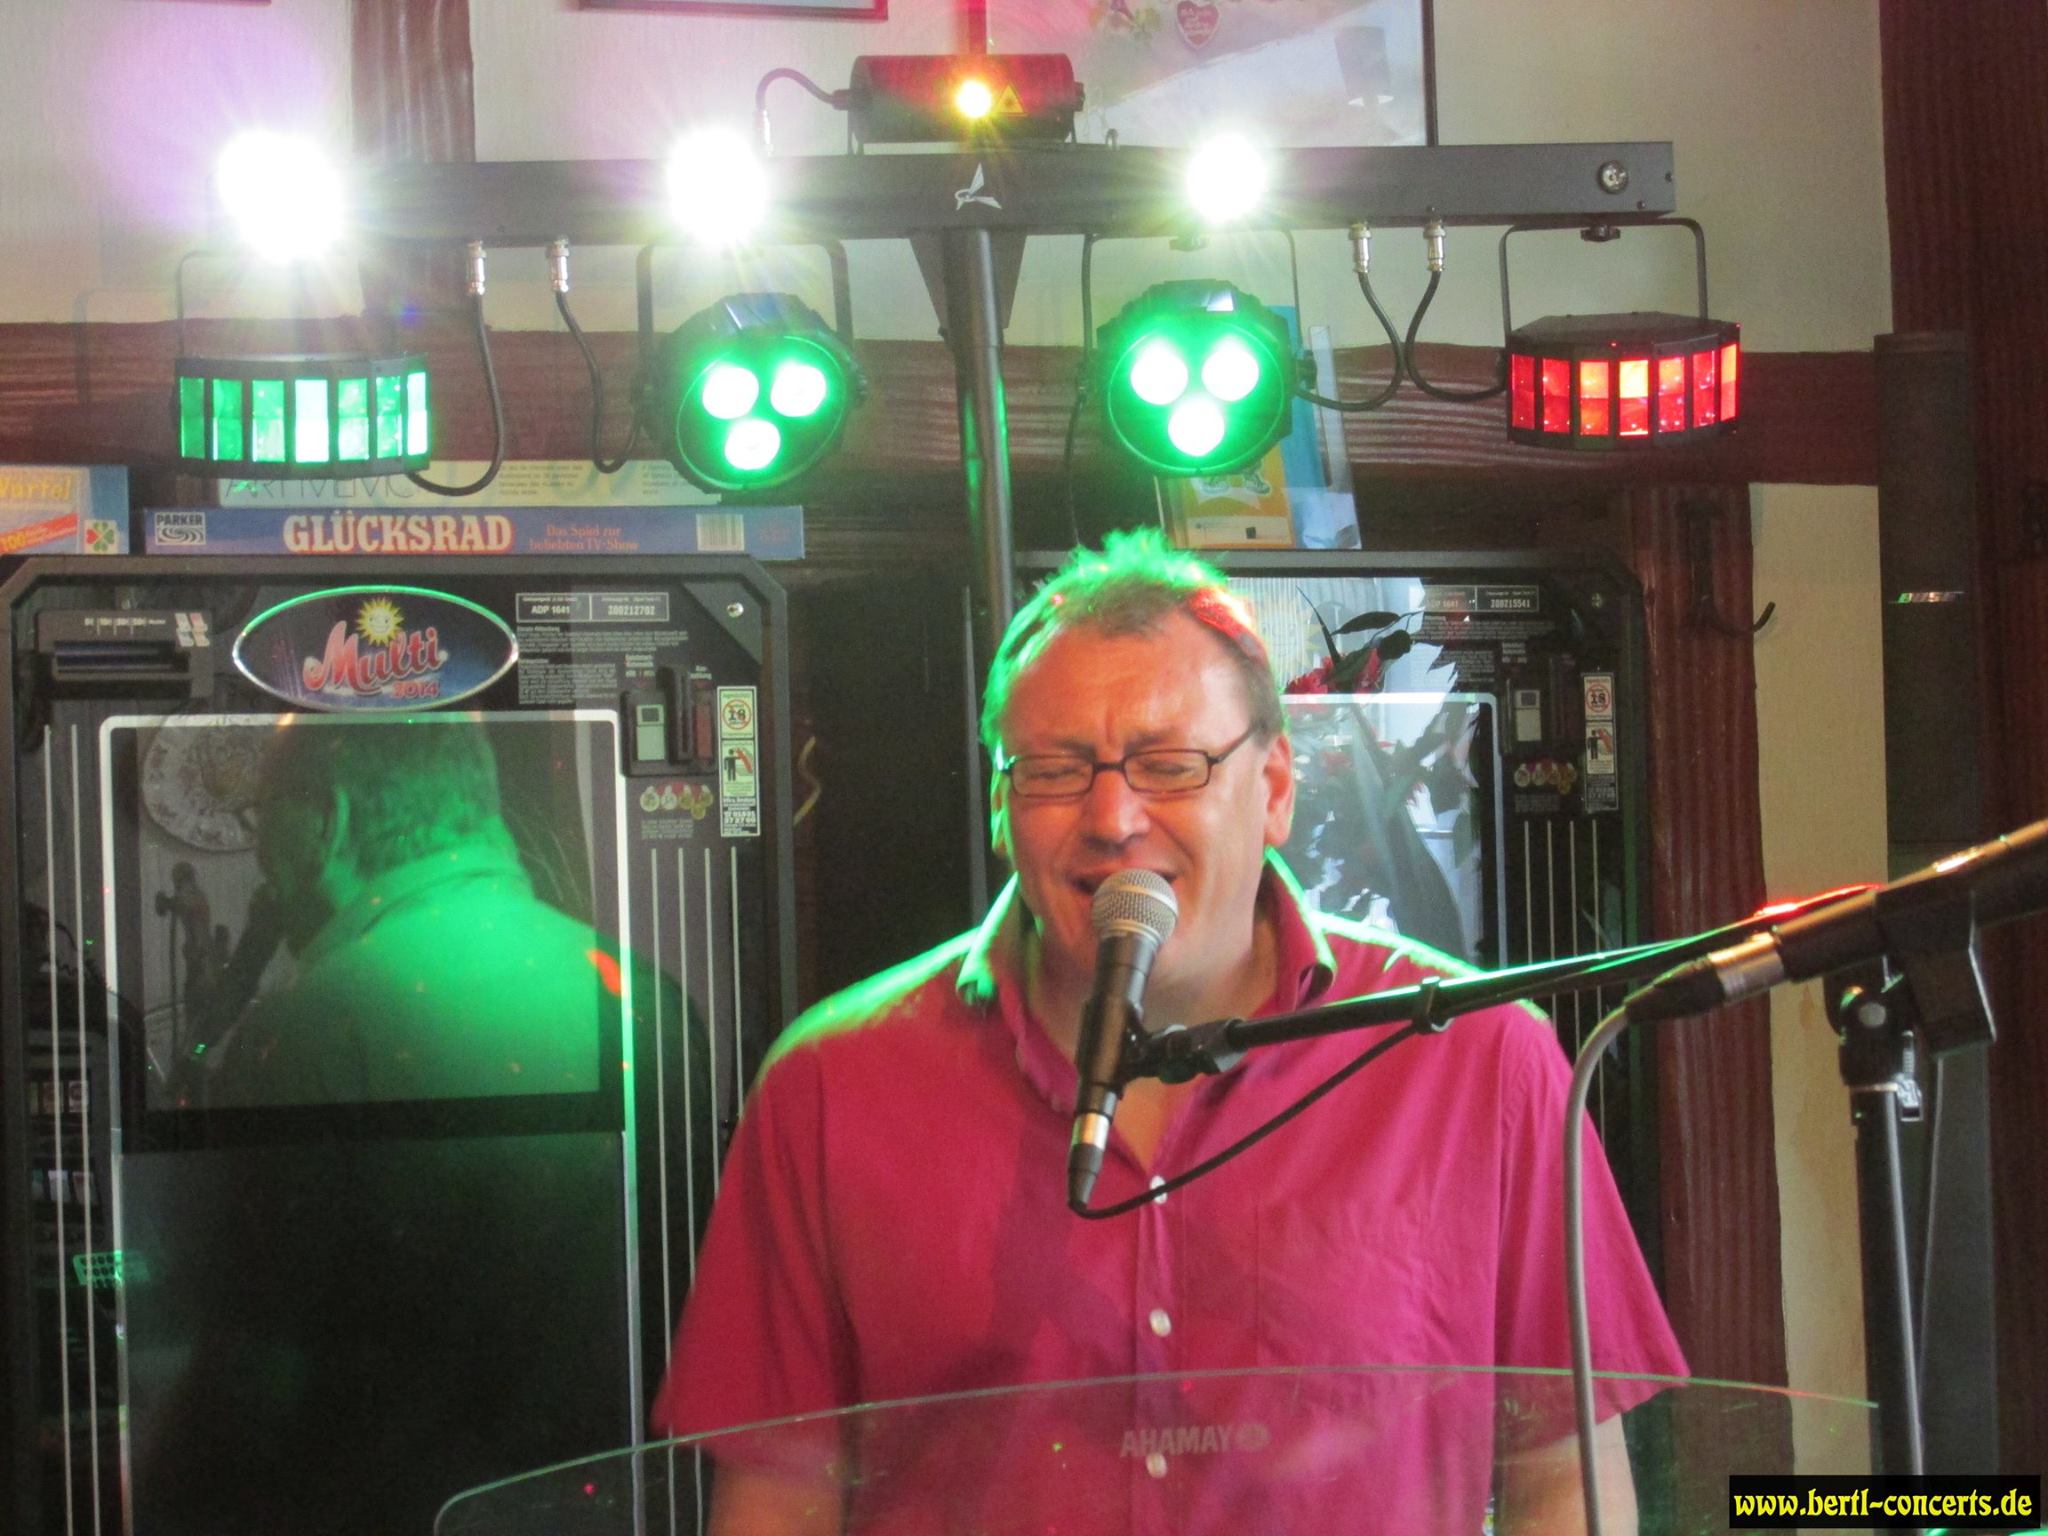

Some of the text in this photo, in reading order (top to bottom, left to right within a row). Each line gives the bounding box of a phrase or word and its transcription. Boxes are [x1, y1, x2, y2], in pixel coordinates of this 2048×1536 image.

[156, 514, 203, 526] PARKER
[283, 509, 514, 552] GLÜCKSRAD
[546, 524, 622, 539] Das Spiel zur
[531, 605, 549, 615] ADP
[303, 620, 441, 695] Multi
[391, 681, 439, 698] 2014
